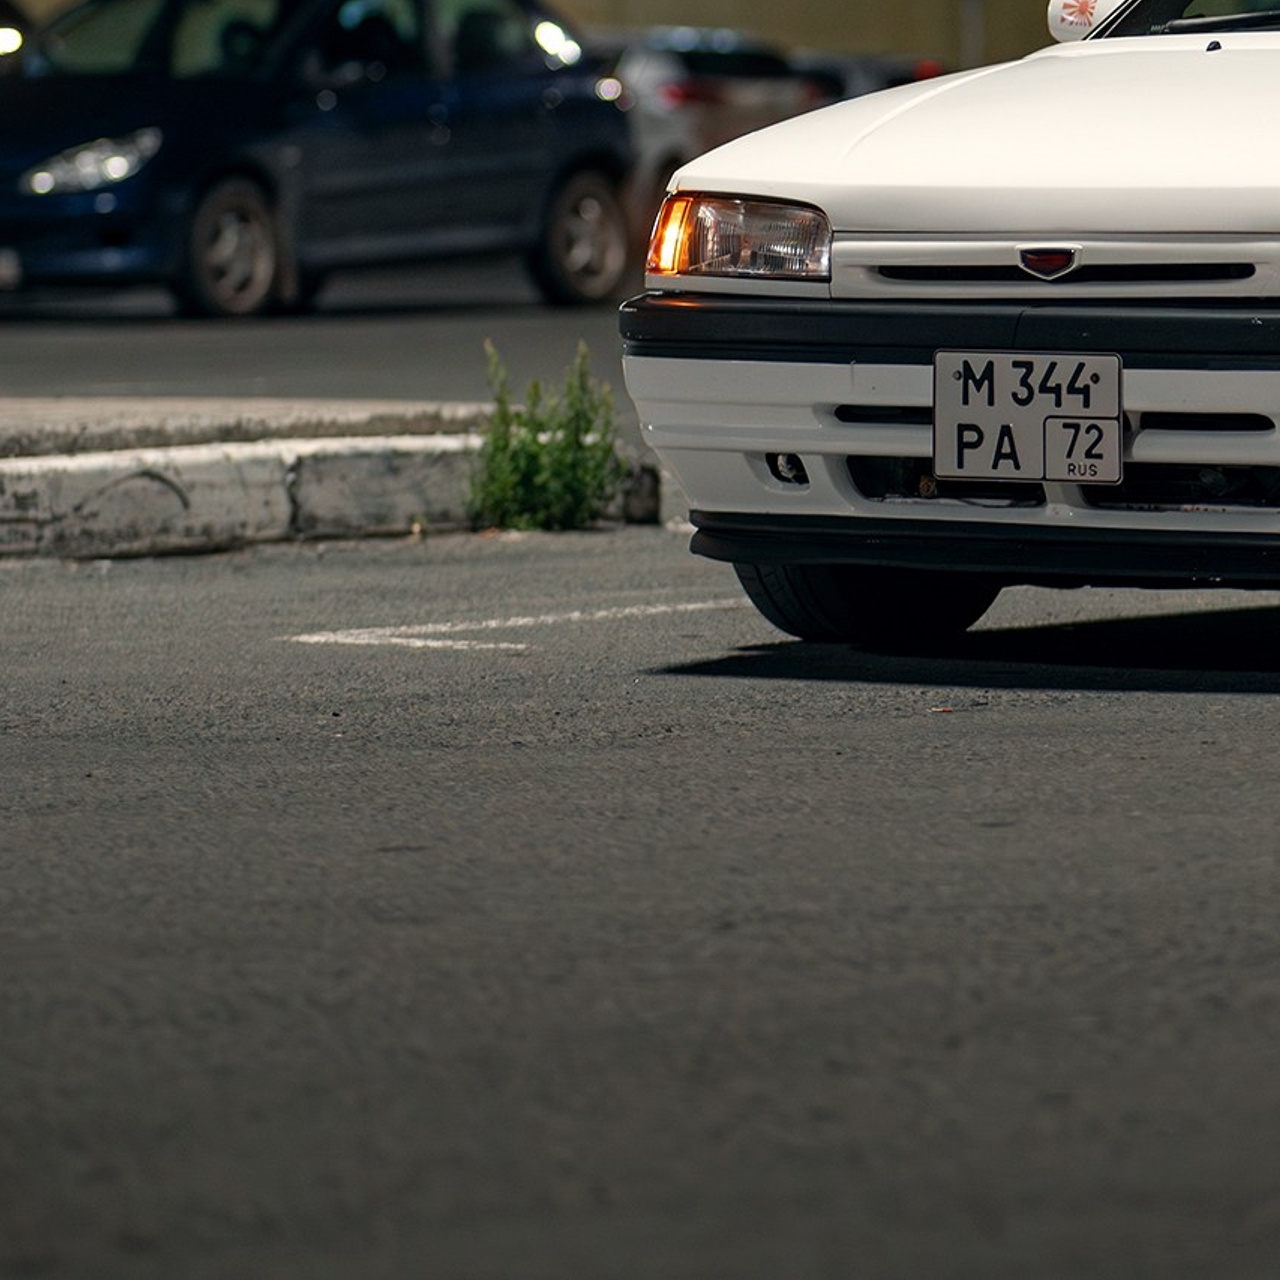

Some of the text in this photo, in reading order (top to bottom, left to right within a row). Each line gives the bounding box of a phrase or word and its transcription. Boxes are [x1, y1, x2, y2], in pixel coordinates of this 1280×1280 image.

[962, 360, 1091, 408] М 344
[956, 423, 1104, 470] РА 72
[1067, 463, 1098, 477] RUS
